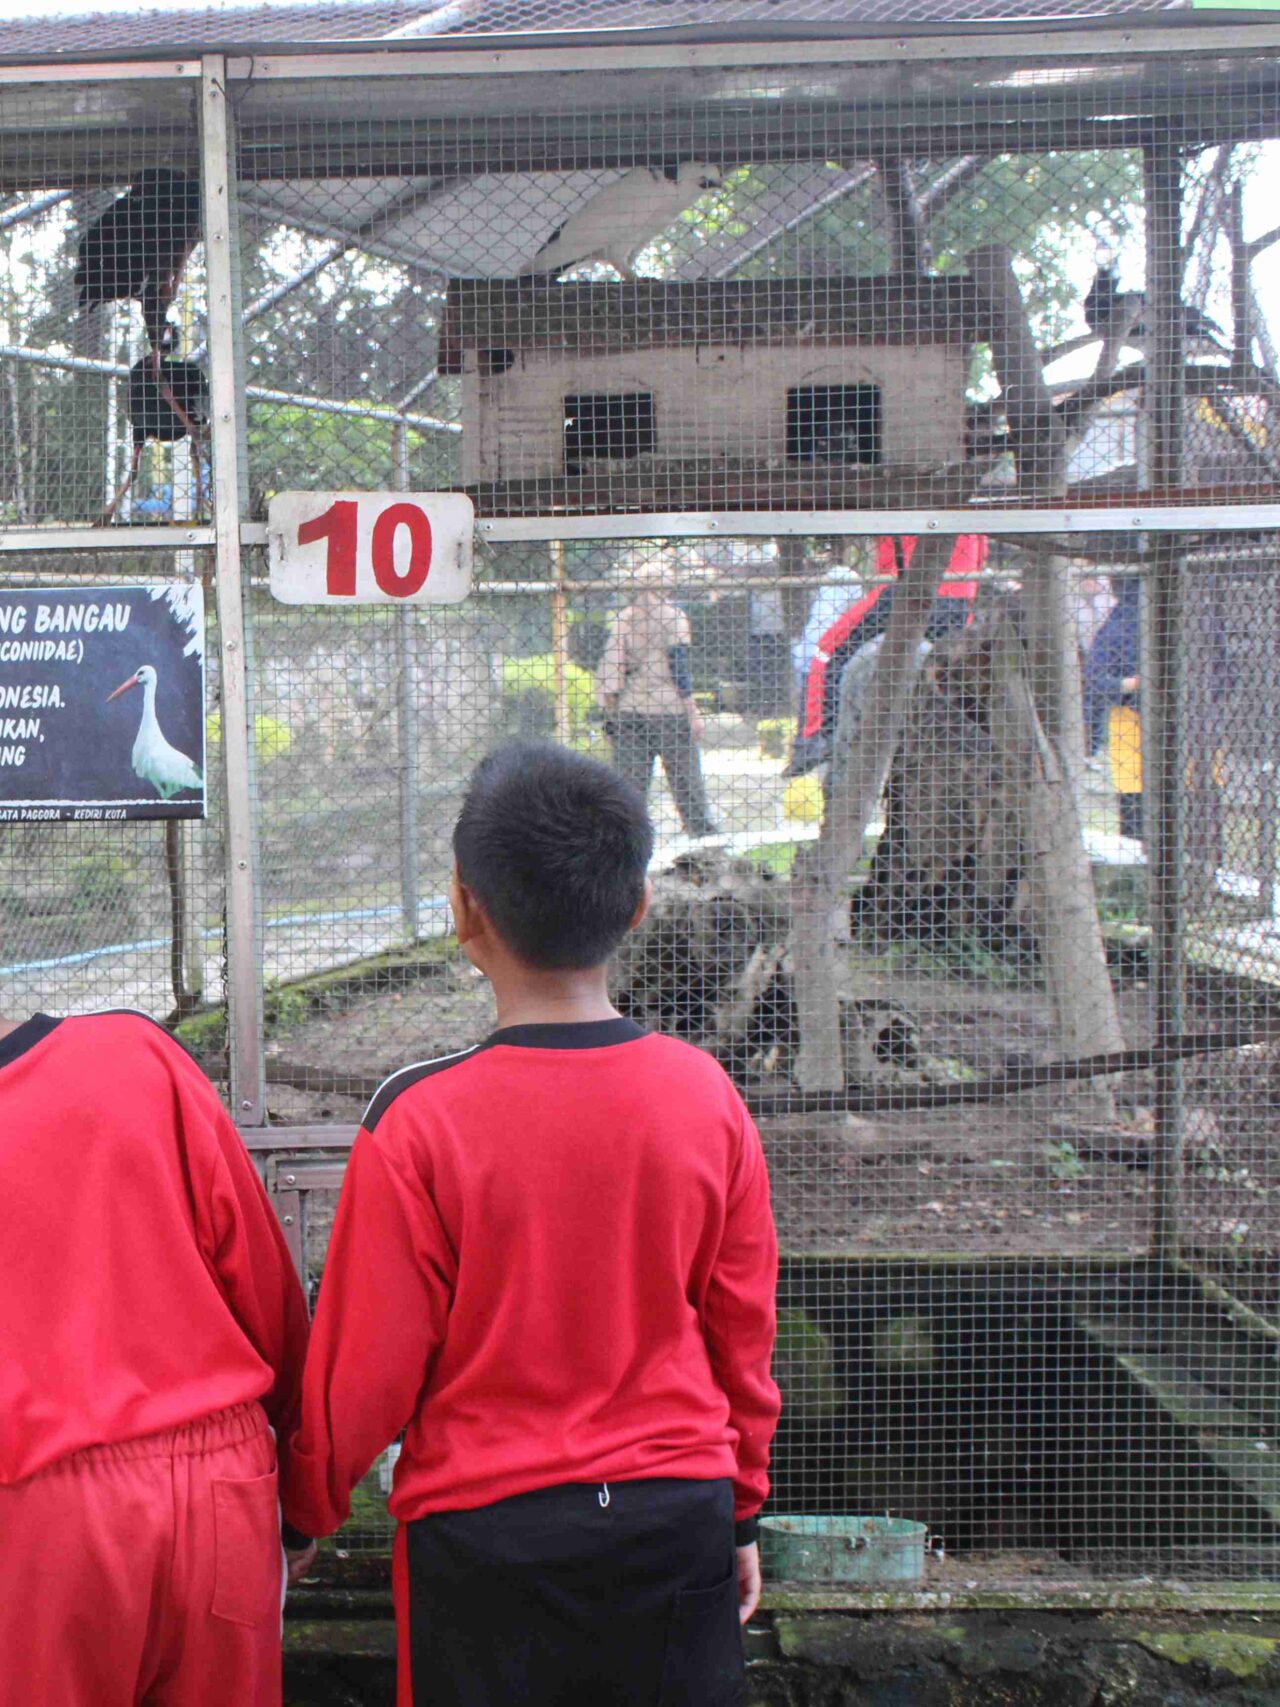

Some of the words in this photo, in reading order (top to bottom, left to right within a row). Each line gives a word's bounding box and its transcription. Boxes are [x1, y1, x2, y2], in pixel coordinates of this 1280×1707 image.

[298, 500, 432, 598] 10
[34, 603, 132, 634] BANGAU
[73, 808, 103, 820] KEDIRI
[104, 808, 128, 820] KOTA
